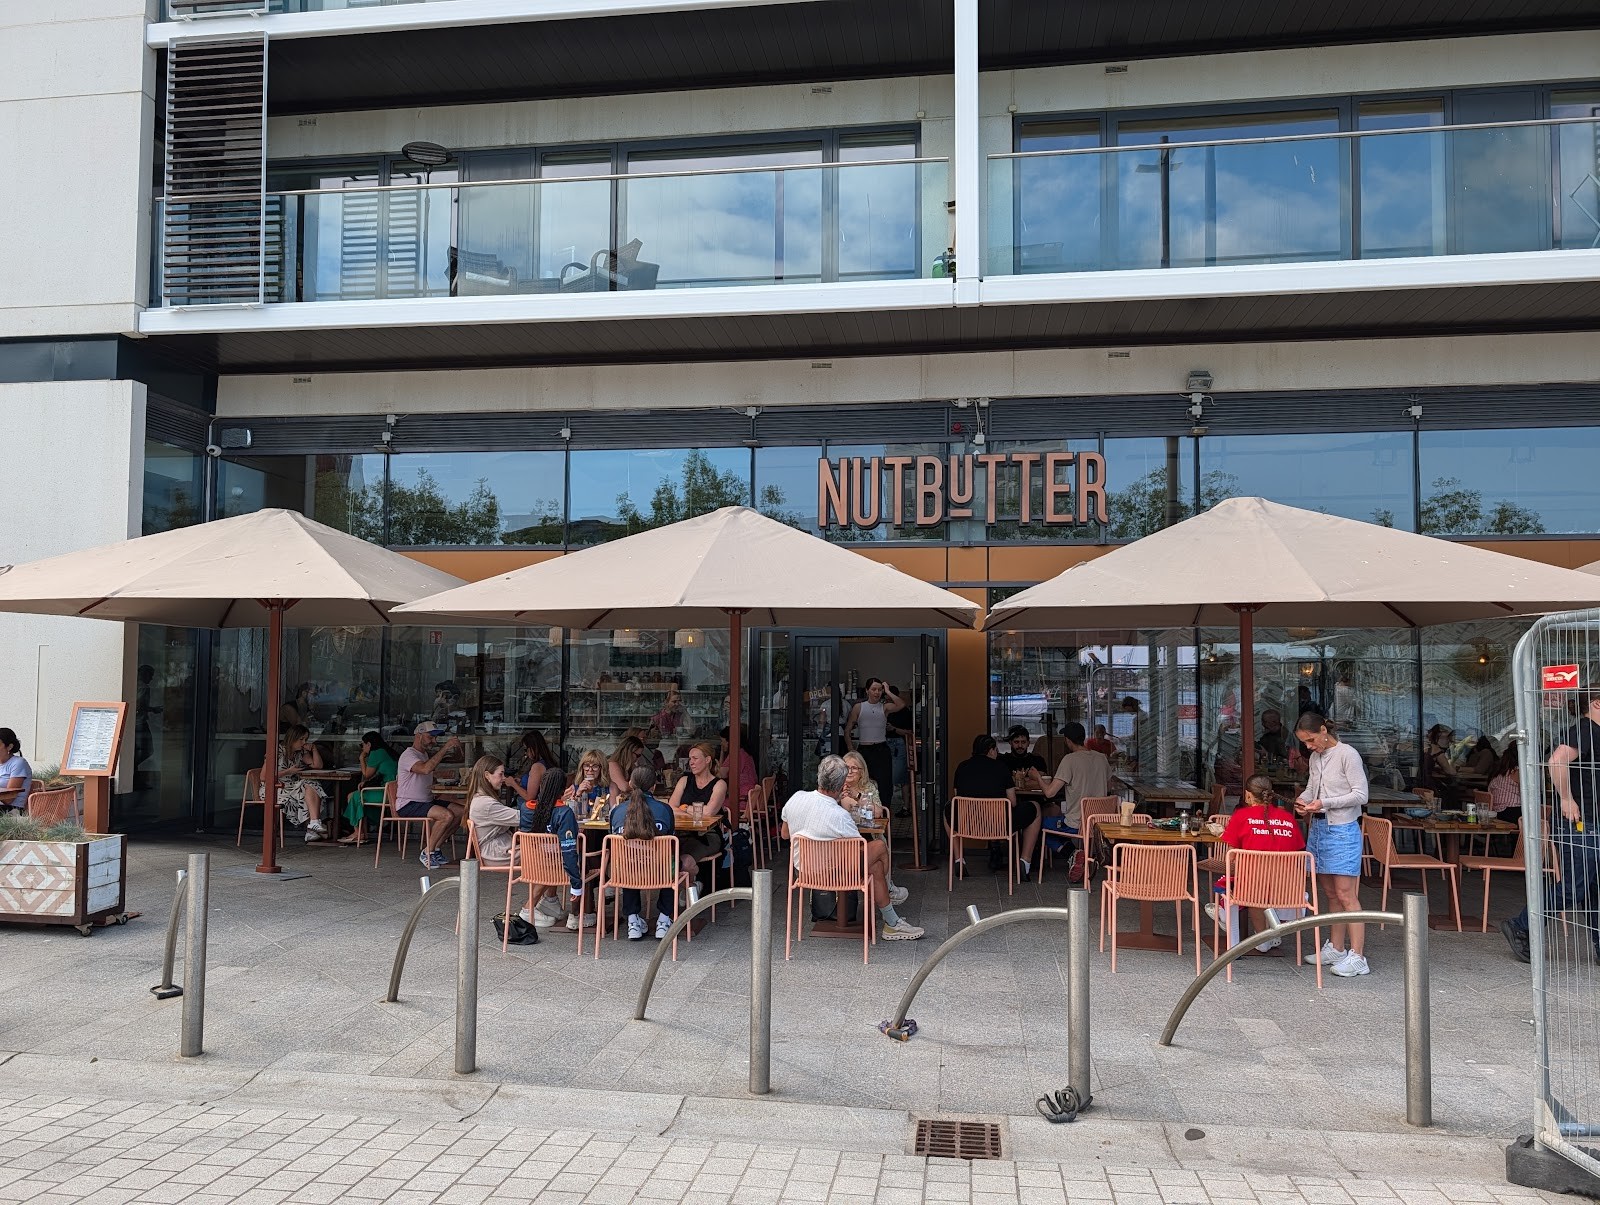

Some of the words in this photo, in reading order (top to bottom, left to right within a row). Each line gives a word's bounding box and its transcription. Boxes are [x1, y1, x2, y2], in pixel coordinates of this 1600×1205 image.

[818, 451, 1109, 528] NUTBUTTER
[809, 688, 828, 699] OPEN
[1267, 819, 1293, 828] NGLAND
[1252, 827, 1270, 835] Team
[1273, 829, 1292, 837] KLDC
